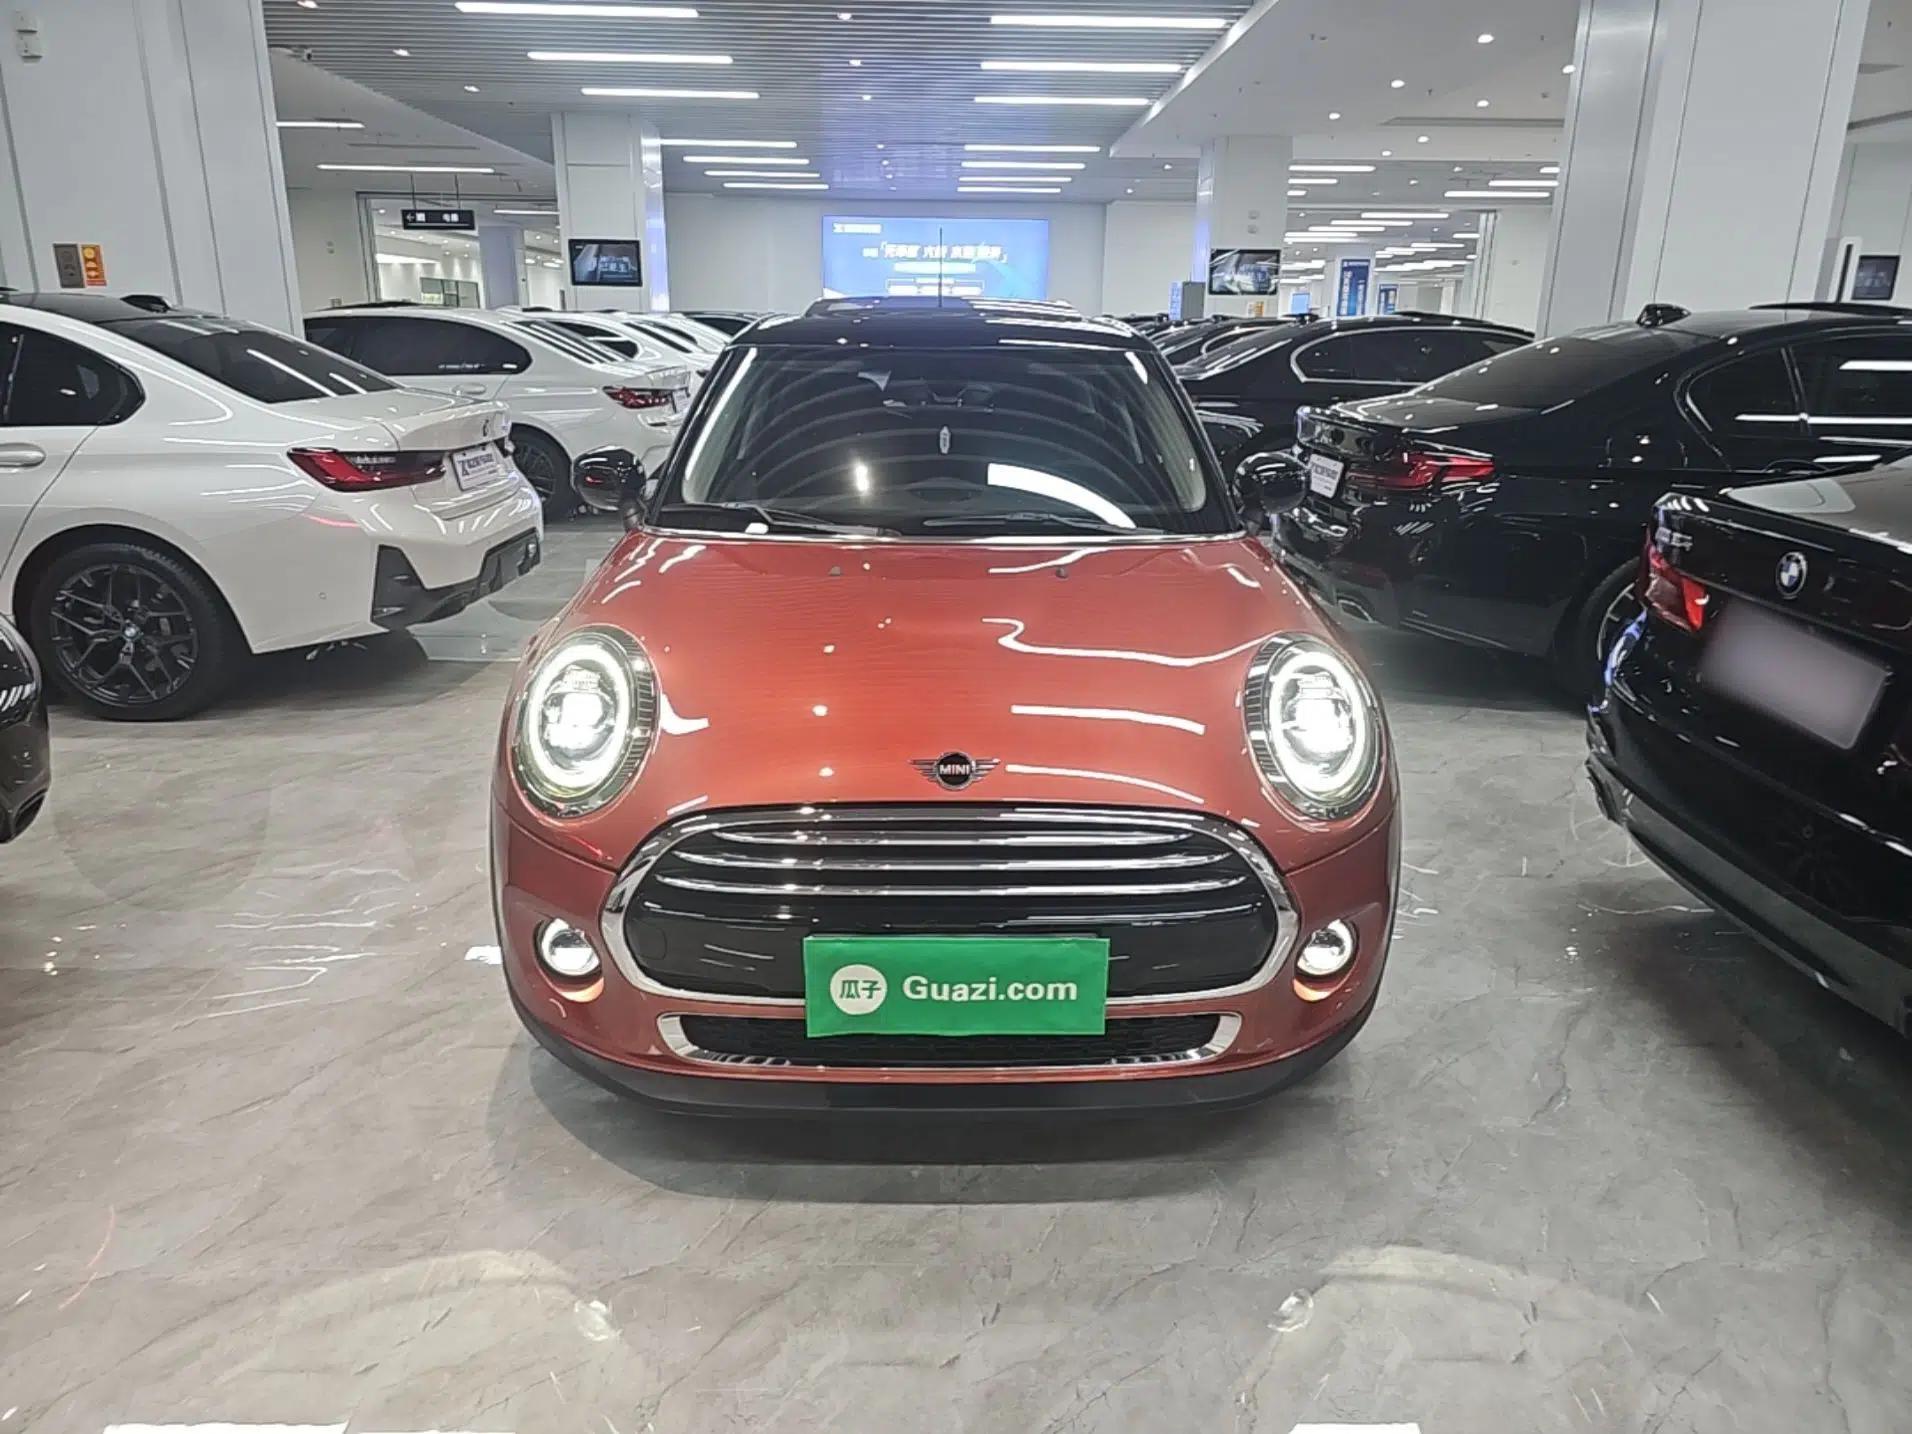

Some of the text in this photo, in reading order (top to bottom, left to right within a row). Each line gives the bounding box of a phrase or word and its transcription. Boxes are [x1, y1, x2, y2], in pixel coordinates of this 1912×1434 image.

[939, 764, 969, 775] MINI
[839, 975, 1077, 1002] 瓜子 Guazi.com
